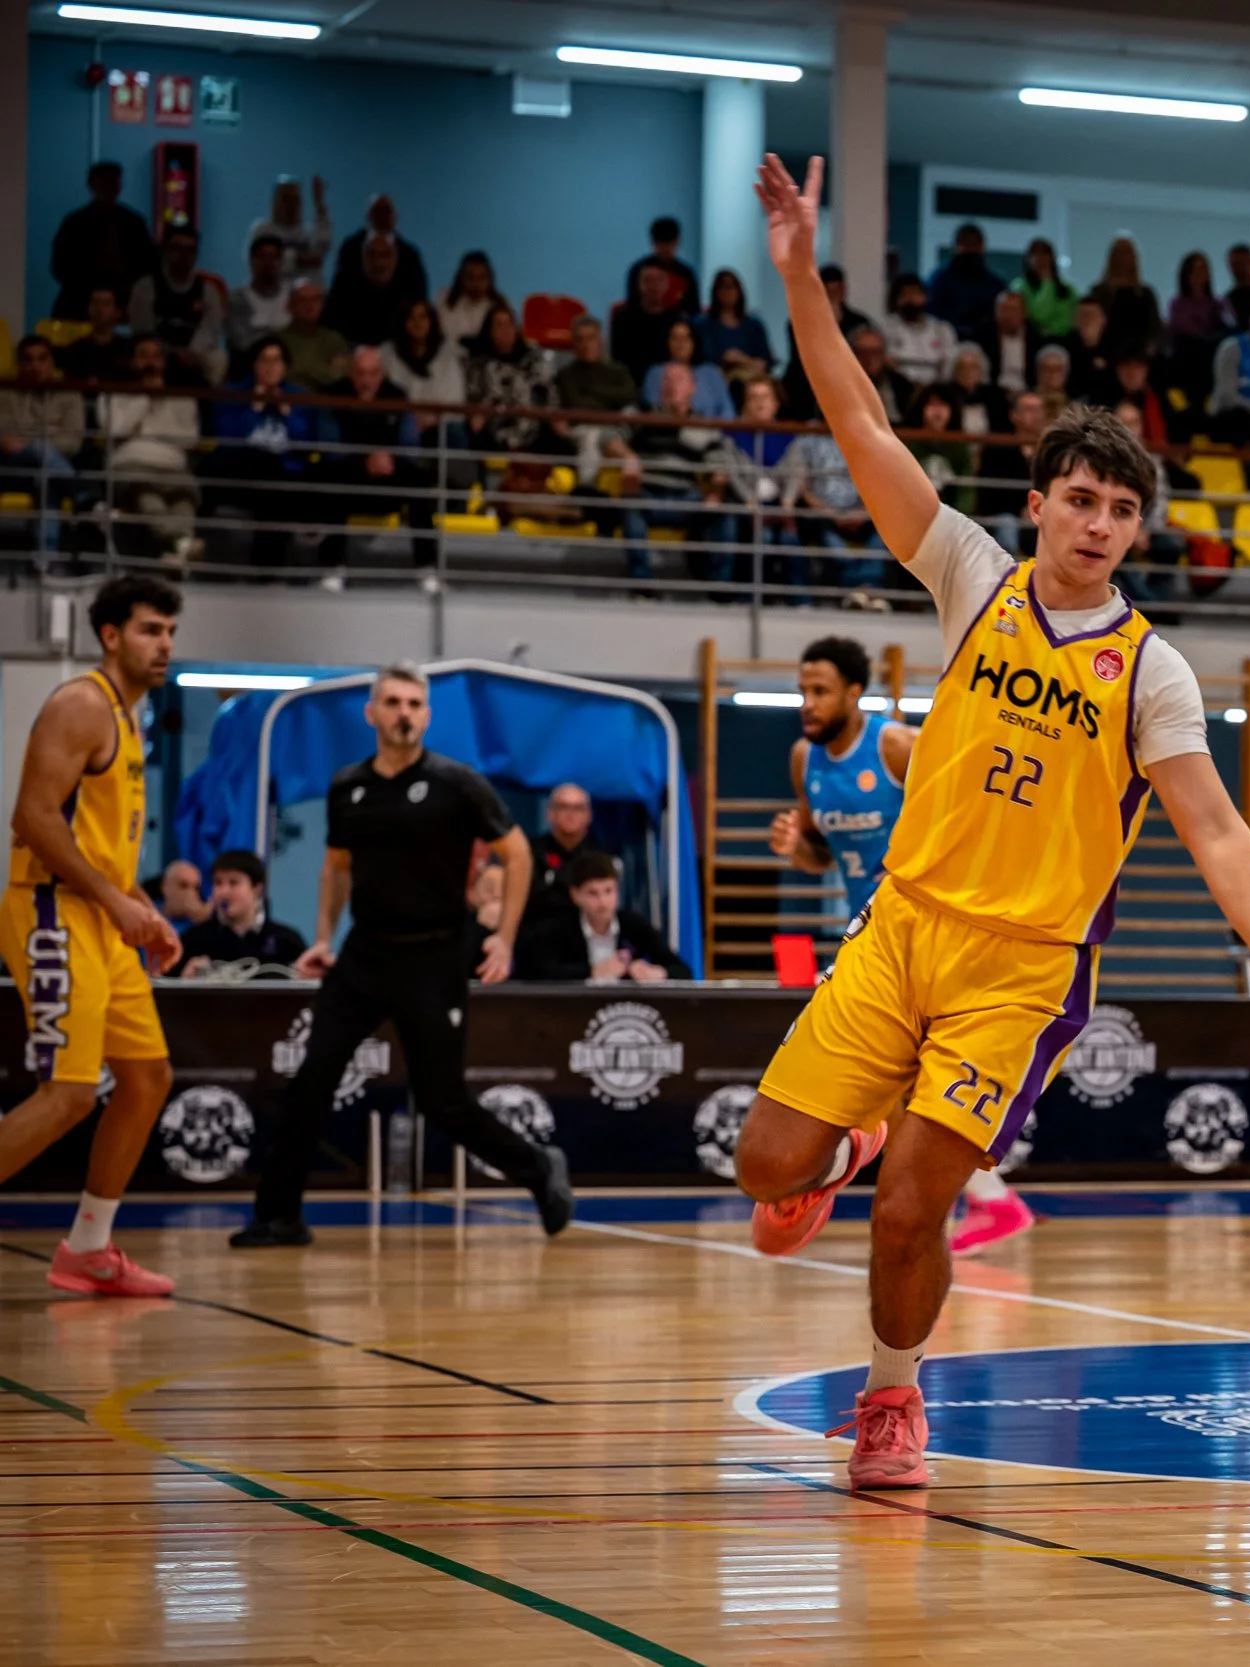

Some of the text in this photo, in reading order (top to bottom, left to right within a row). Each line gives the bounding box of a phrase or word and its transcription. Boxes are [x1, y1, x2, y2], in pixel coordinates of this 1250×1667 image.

[969, 653, 1101, 739] HOMS
[997, 708, 1062, 740] RENTALS
[983, 745, 1044, 807] 22
[943, 1061, 1003, 1126] 22
